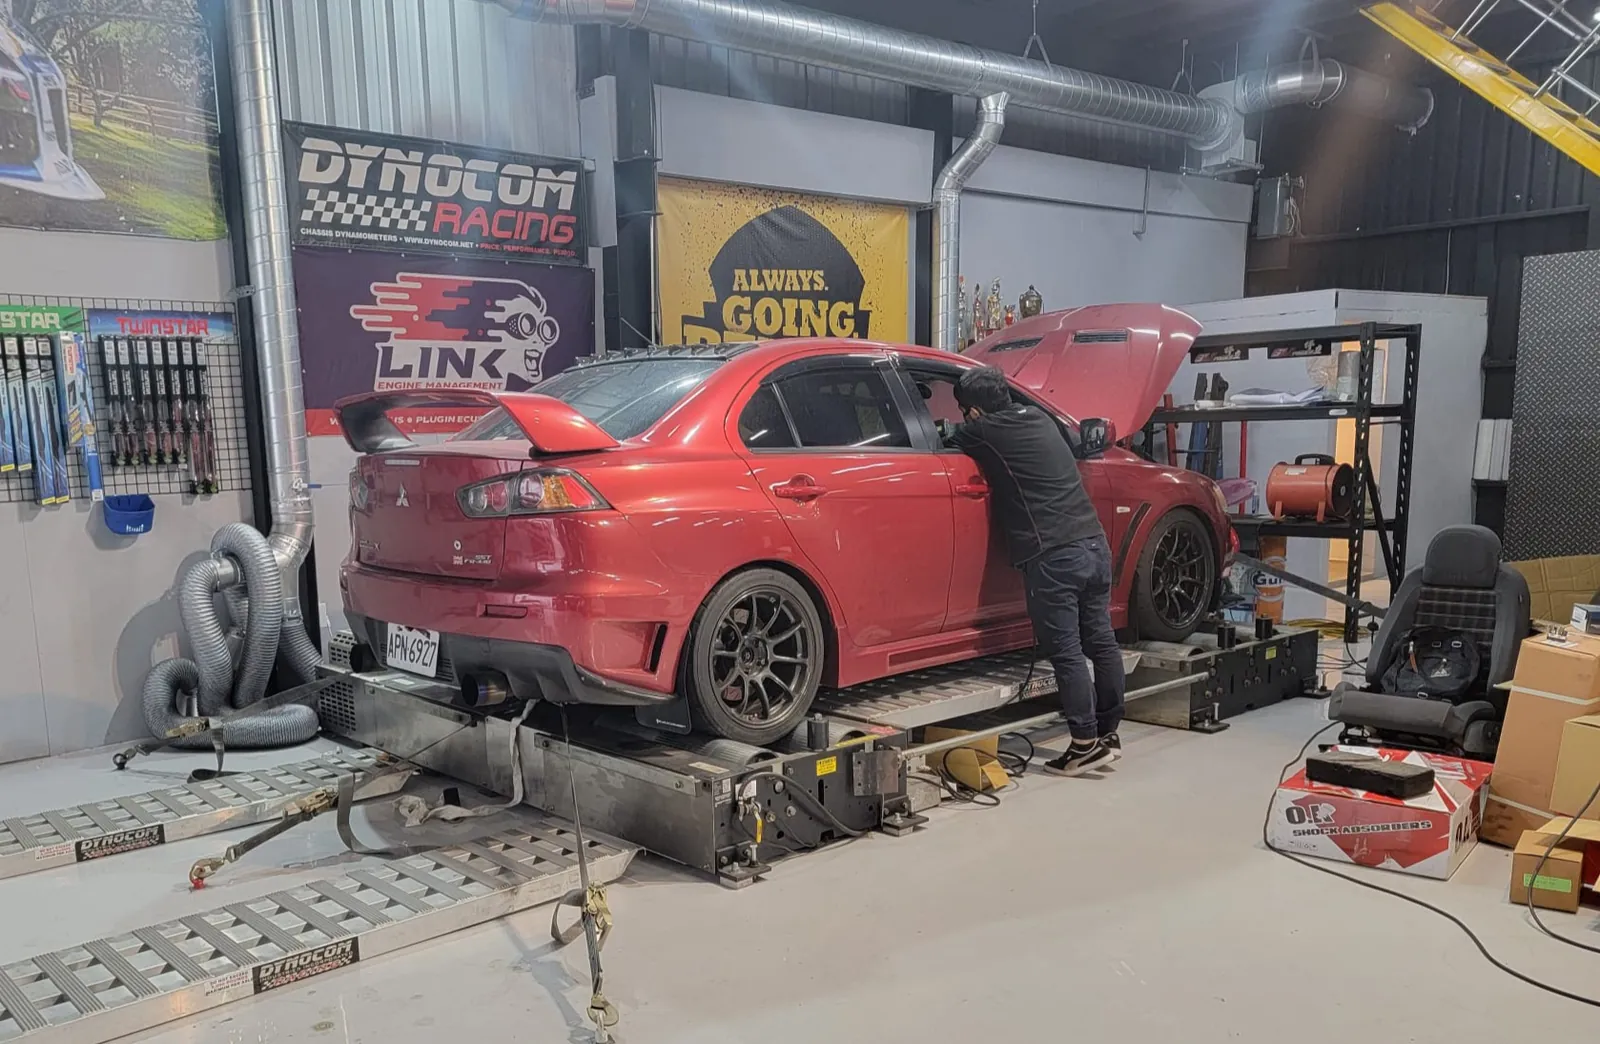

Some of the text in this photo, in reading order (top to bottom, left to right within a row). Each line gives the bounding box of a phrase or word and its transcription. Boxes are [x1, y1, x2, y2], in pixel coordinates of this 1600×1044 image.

[298, 137, 577, 211] DYNOCOM
[432, 203, 576, 243] RACING
[300, 228, 333, 237] CHASSIS
[335, 230, 398, 242] DYNAMOMETERS
[404, 236, 474, 248] WWW.DYNOCOM.NET
[732, 269, 829, 291] ALWAYS.
[115, 317, 209, 336] TWINSTAR
[722, 295, 859, 338] GOING.
[379, 346, 507, 378] LINK
[377, 381, 504, 390] ENGINE MANAGEMENT
[416, 415, 456, 424] PLUGIN
[80, 826, 159, 851] DYNOCOM
[1292, 826, 1340, 837] SHOCK
[259, 940, 353, 978] DYNOCOM
